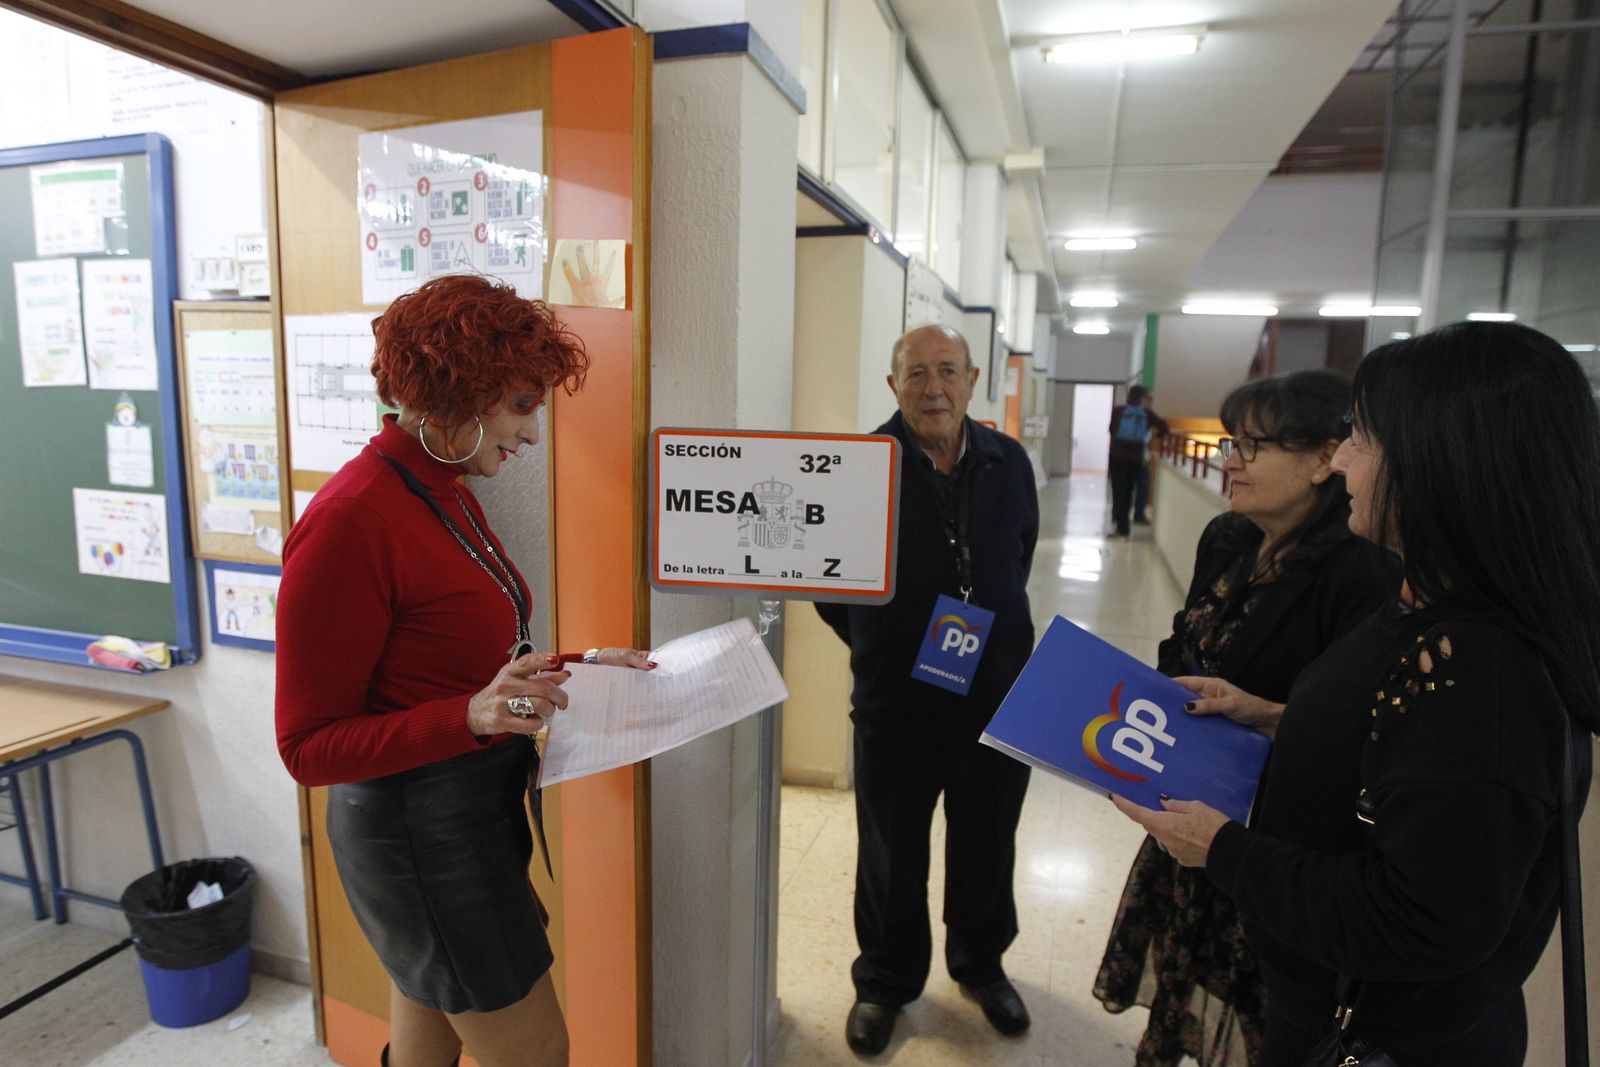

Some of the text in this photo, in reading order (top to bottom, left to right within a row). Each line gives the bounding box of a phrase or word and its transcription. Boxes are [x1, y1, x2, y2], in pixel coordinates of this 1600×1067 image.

[665, 443, 741, 459] SECCIÓN
[665, 488, 826, 525] MESA B
[663, 554, 841, 579] De la letra L a la Z
[941, 627, 980, 657] pp
[919, 663, 966, 685] APODERADO/A
[1111, 698, 1177, 774] pp
